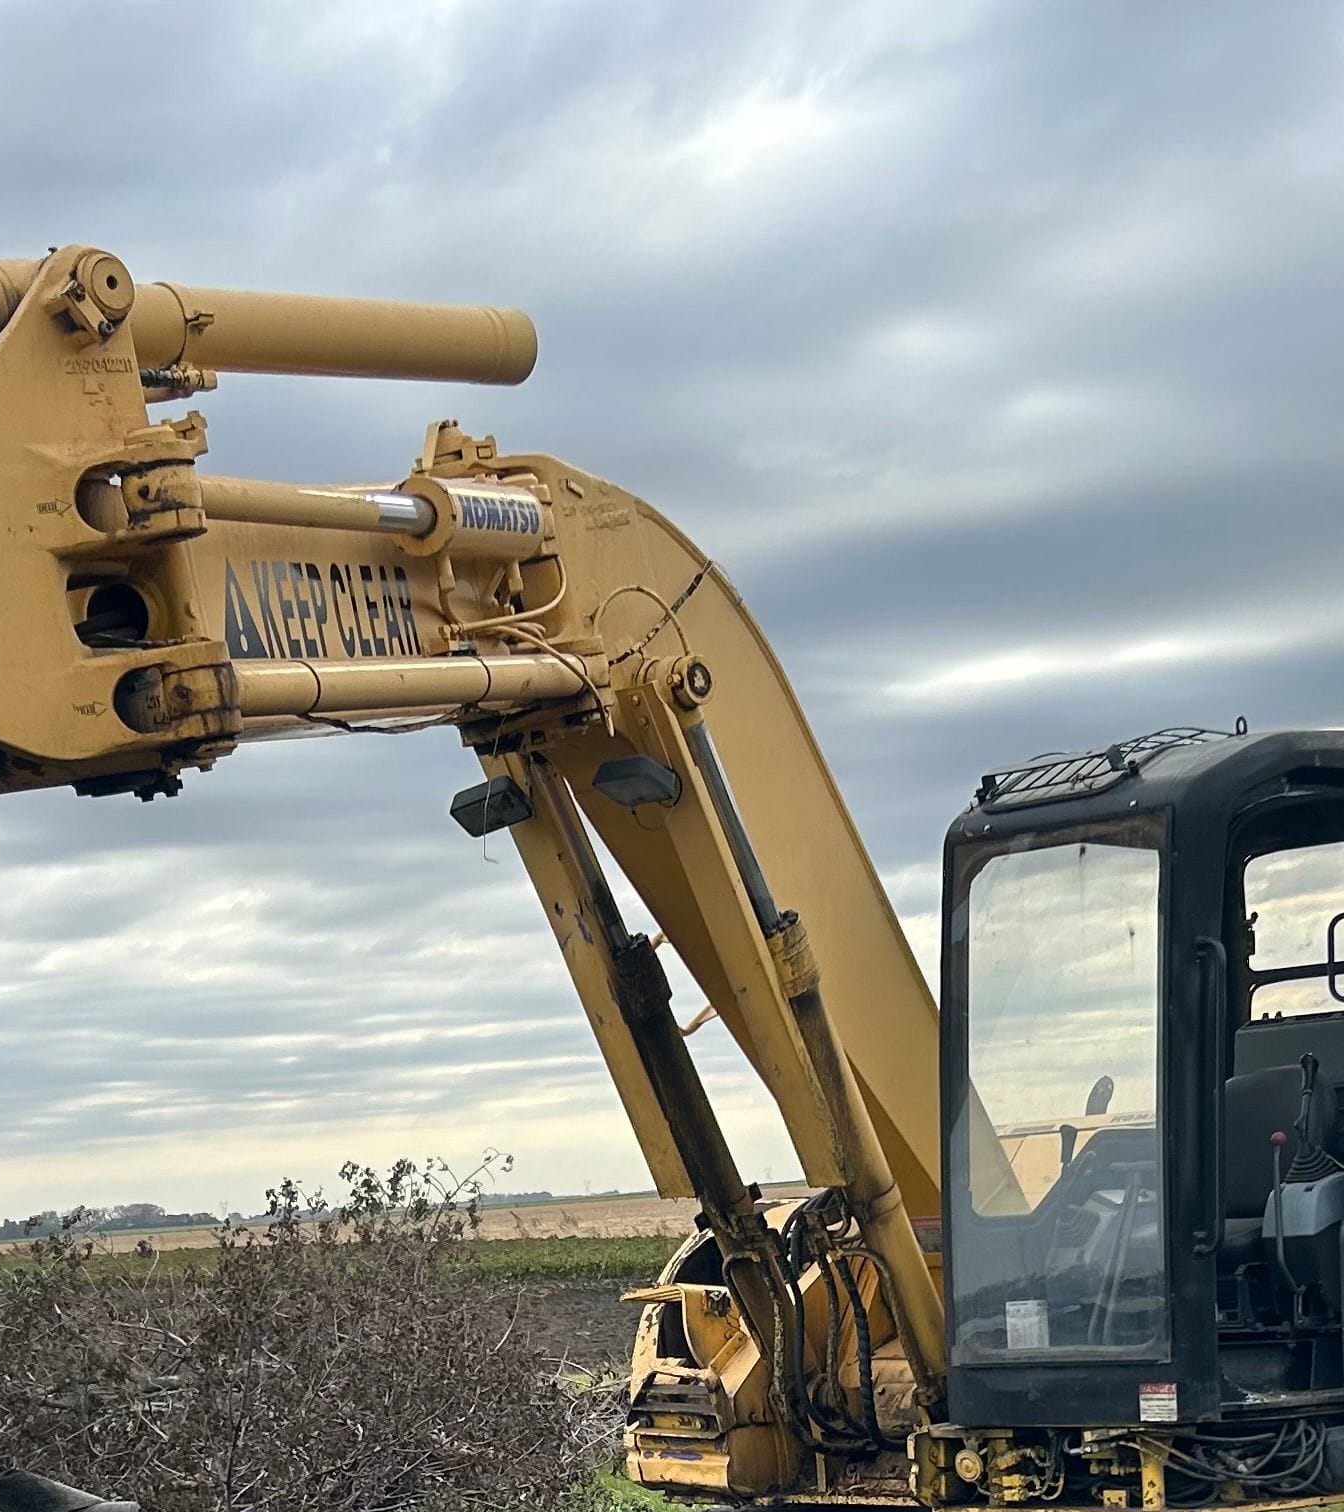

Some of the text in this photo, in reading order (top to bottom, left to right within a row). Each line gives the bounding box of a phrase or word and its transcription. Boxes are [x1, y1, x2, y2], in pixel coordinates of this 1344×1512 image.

[459, 495, 539, 534] KOMATSU
[251, 560, 422, 659] KEEP CLEAR
